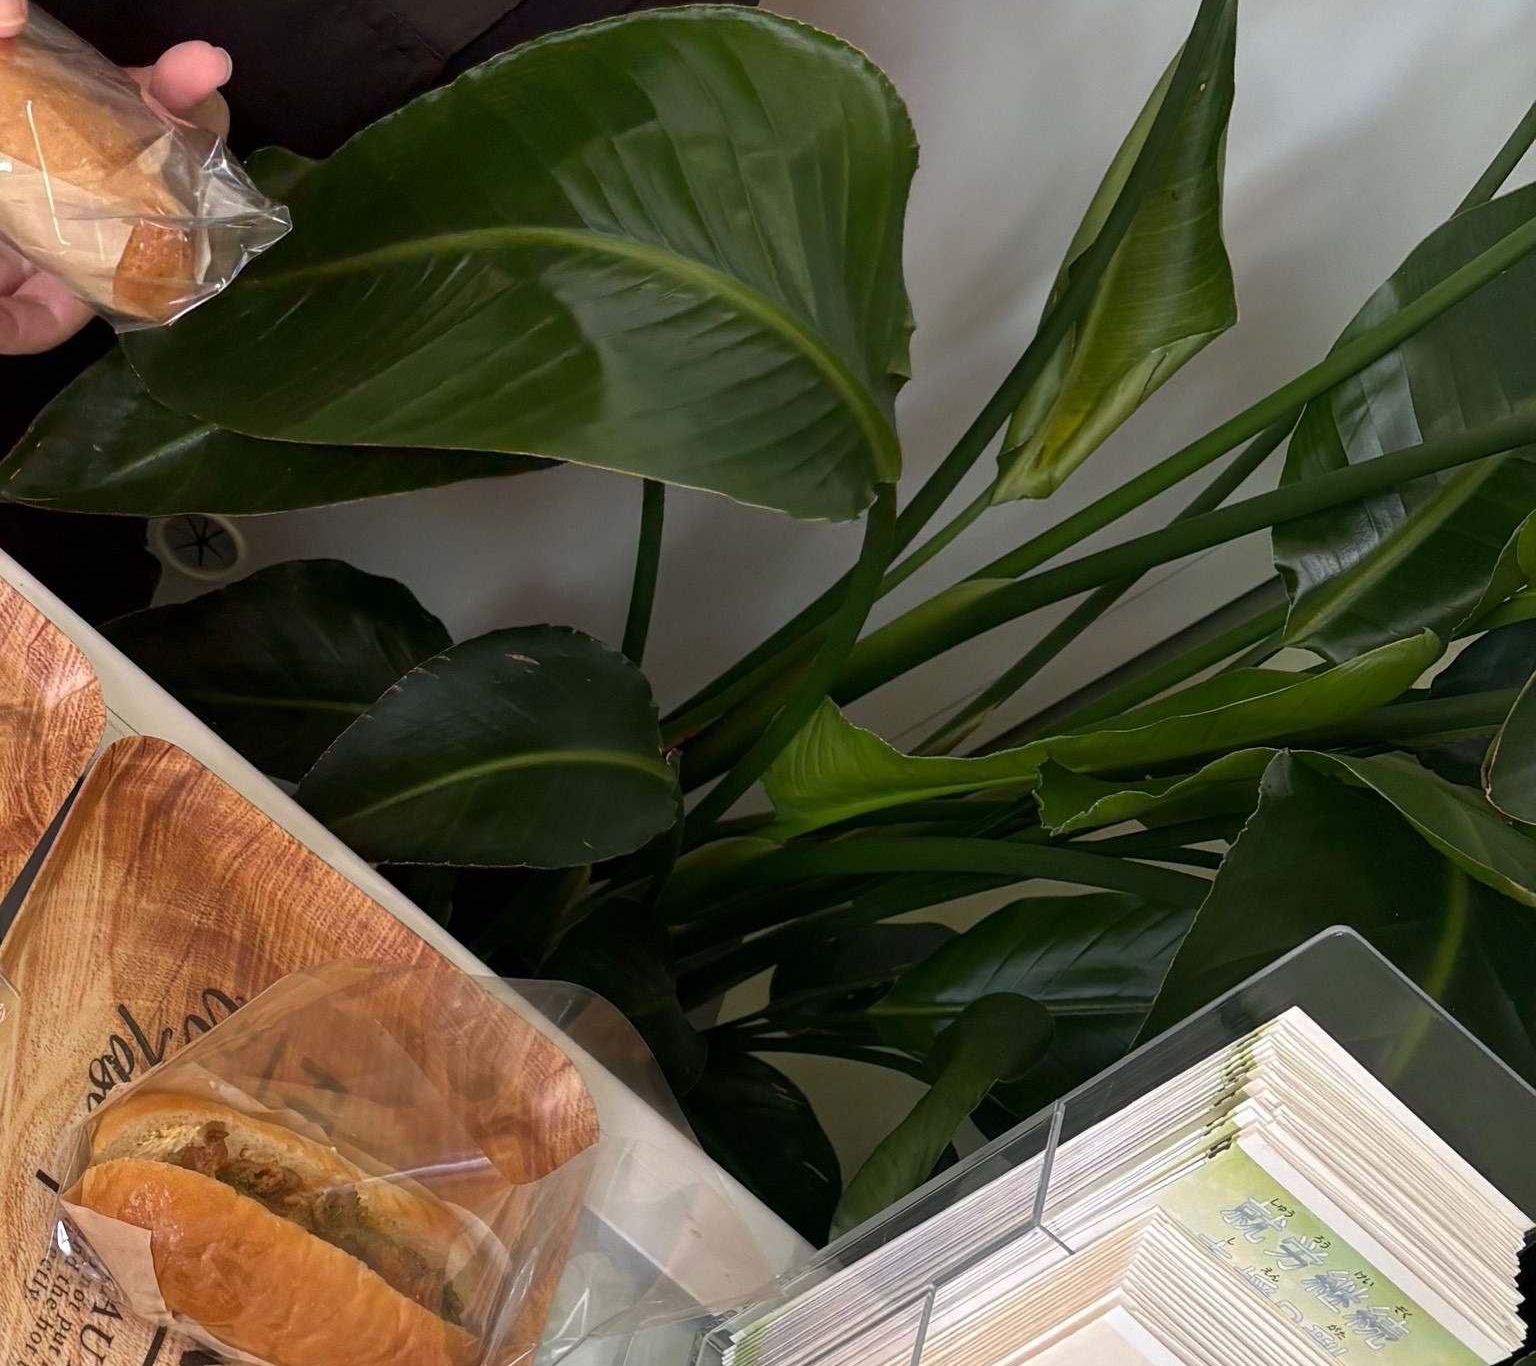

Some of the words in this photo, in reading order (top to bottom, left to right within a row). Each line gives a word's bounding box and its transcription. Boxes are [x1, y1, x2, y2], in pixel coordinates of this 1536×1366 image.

[1220, 1197, 1411, 1351] 就労継続
[25, 1316, 54, 1356] hot
[49, 1312, 72, 1357] put
